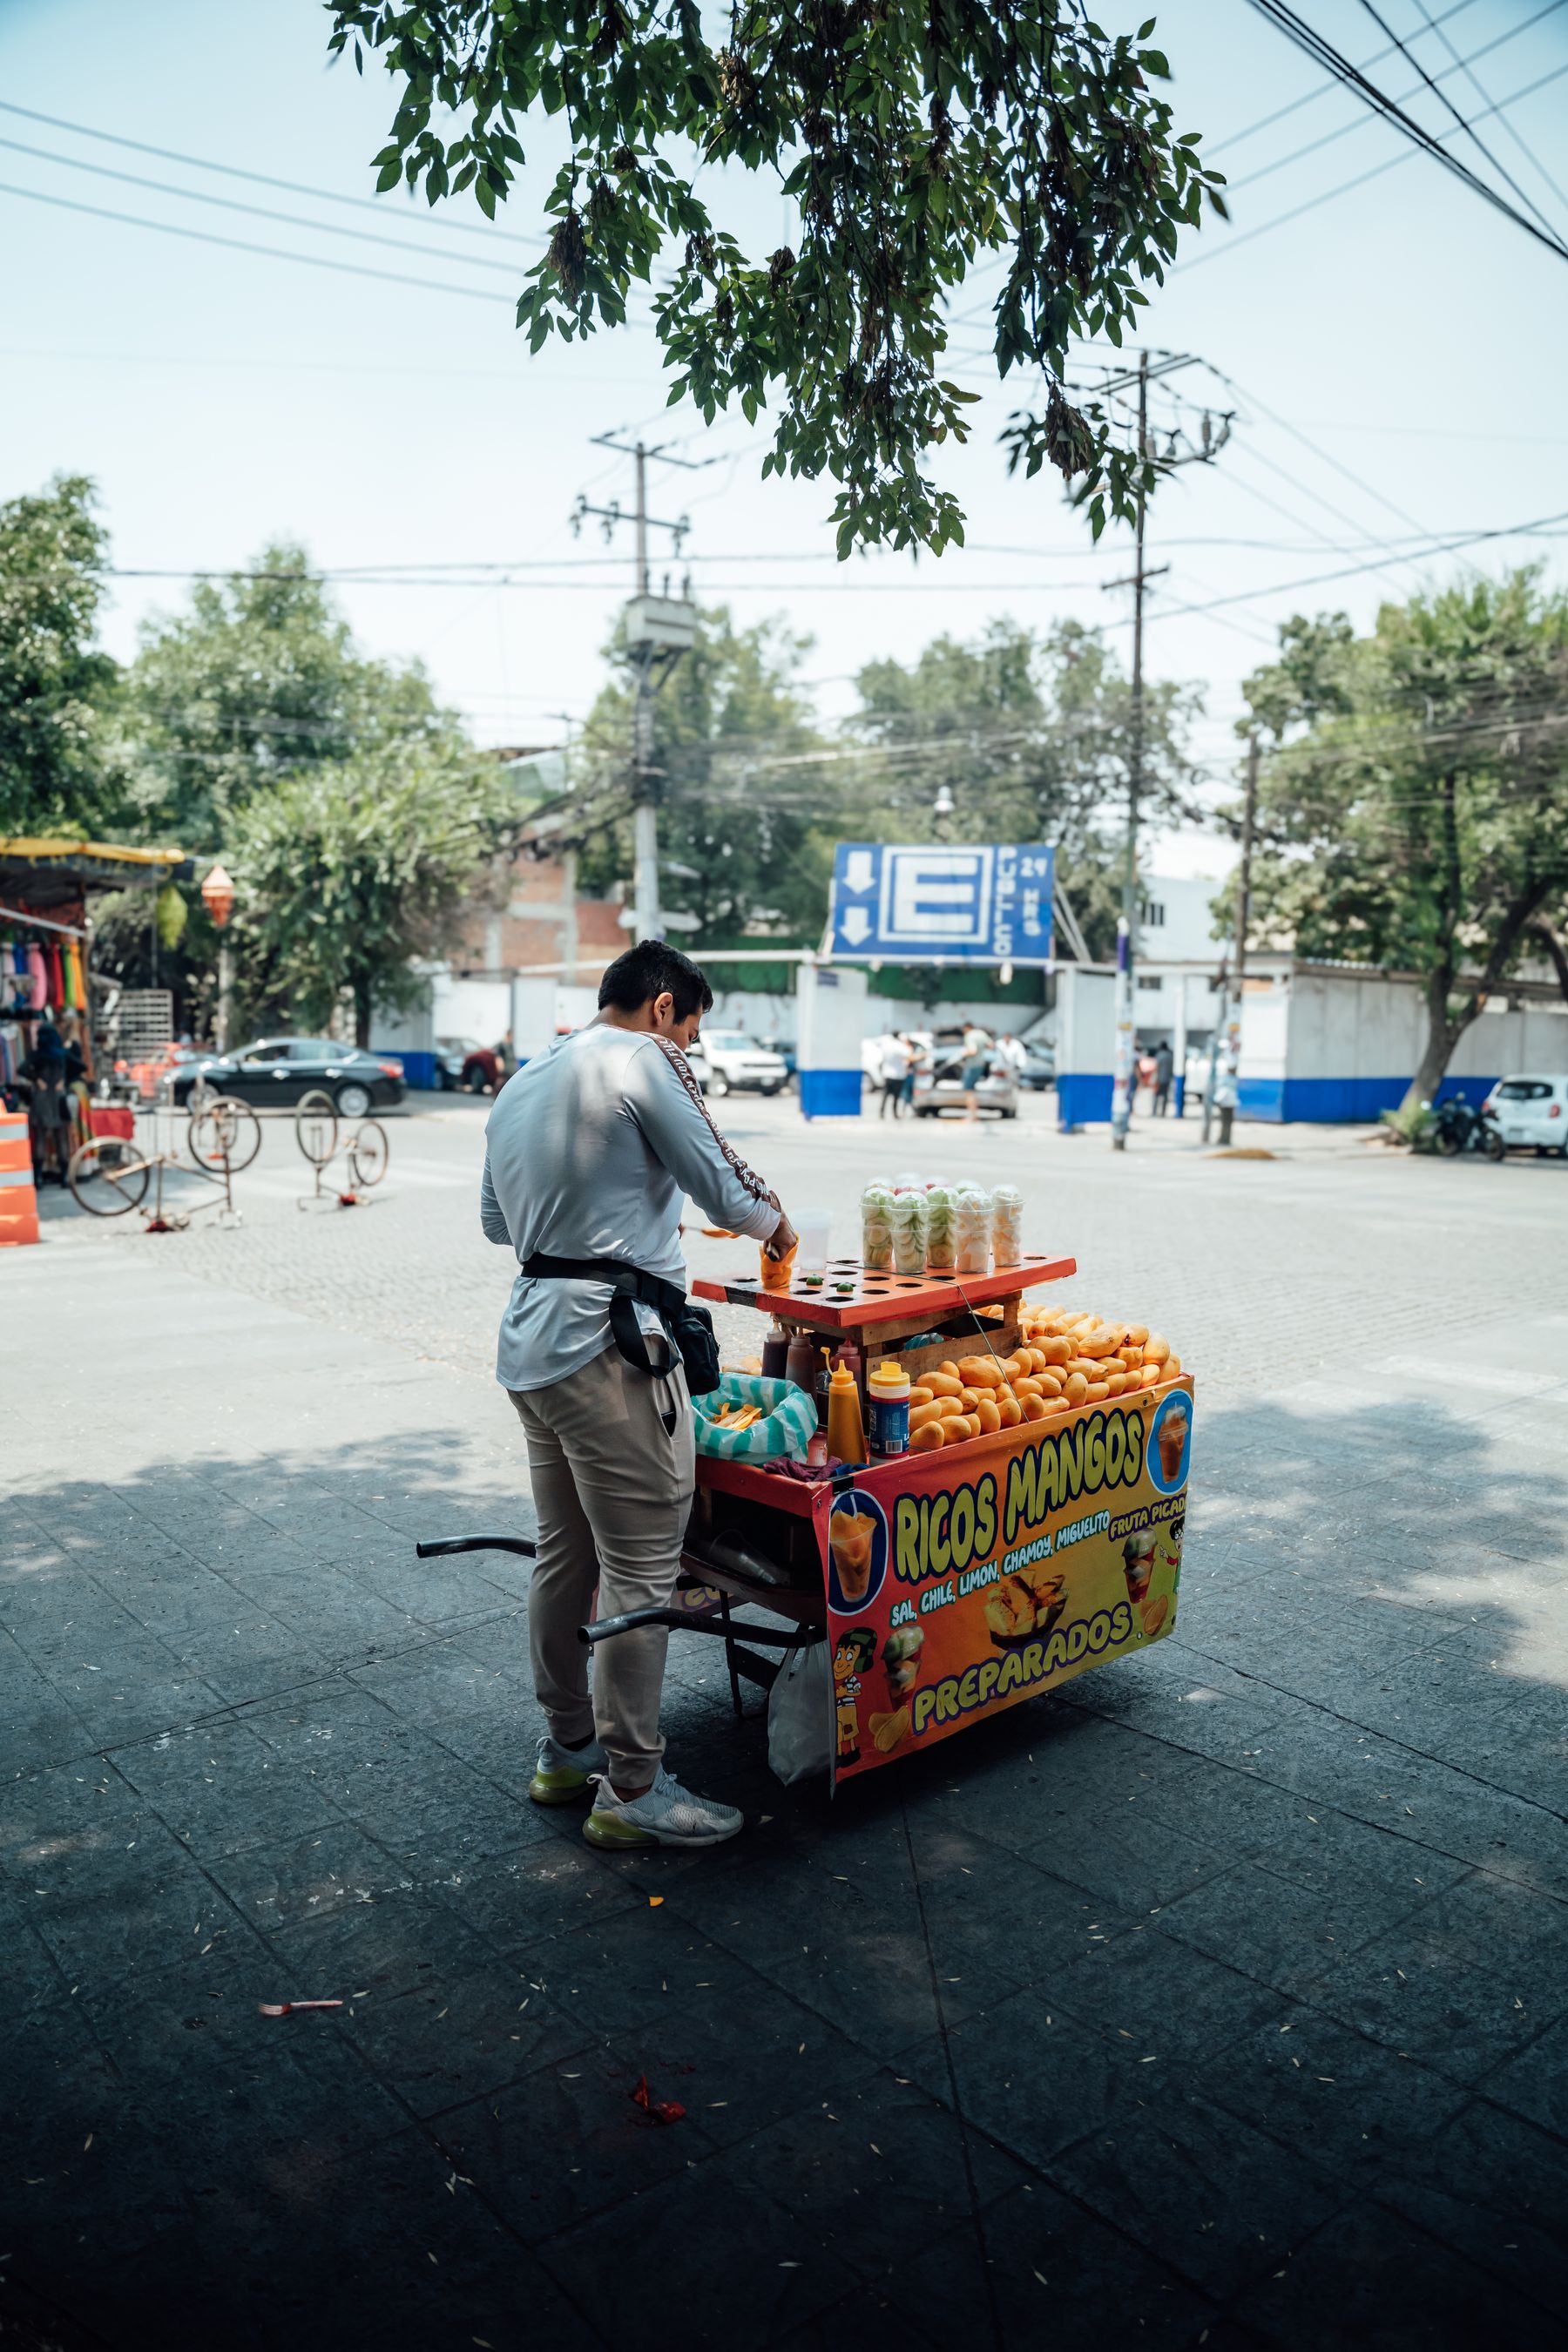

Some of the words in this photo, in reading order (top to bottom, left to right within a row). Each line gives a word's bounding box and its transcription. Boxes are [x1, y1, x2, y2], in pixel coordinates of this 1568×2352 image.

[893, 855, 978, 933] E
[1020, 856, 1047, 877] 24
[673, 1058, 692, 1079] YOU
[894, 1475, 997, 1583] RICOS
[1005, 1409, 1144, 1543] MANGOS
[1109, 1508, 1148, 1540] FRUTA
[890, 1599, 917, 1626] SAL,
[921, 1581, 956, 1613] CHILE,
[959, 1560, 1000, 1595] LIMON,
[1004, 1535, 1053, 1574] CHAMOY,
[1057, 1511, 1110, 1550] MIGUELITO
[913, 1603, 1132, 1734] PREPARADOS
